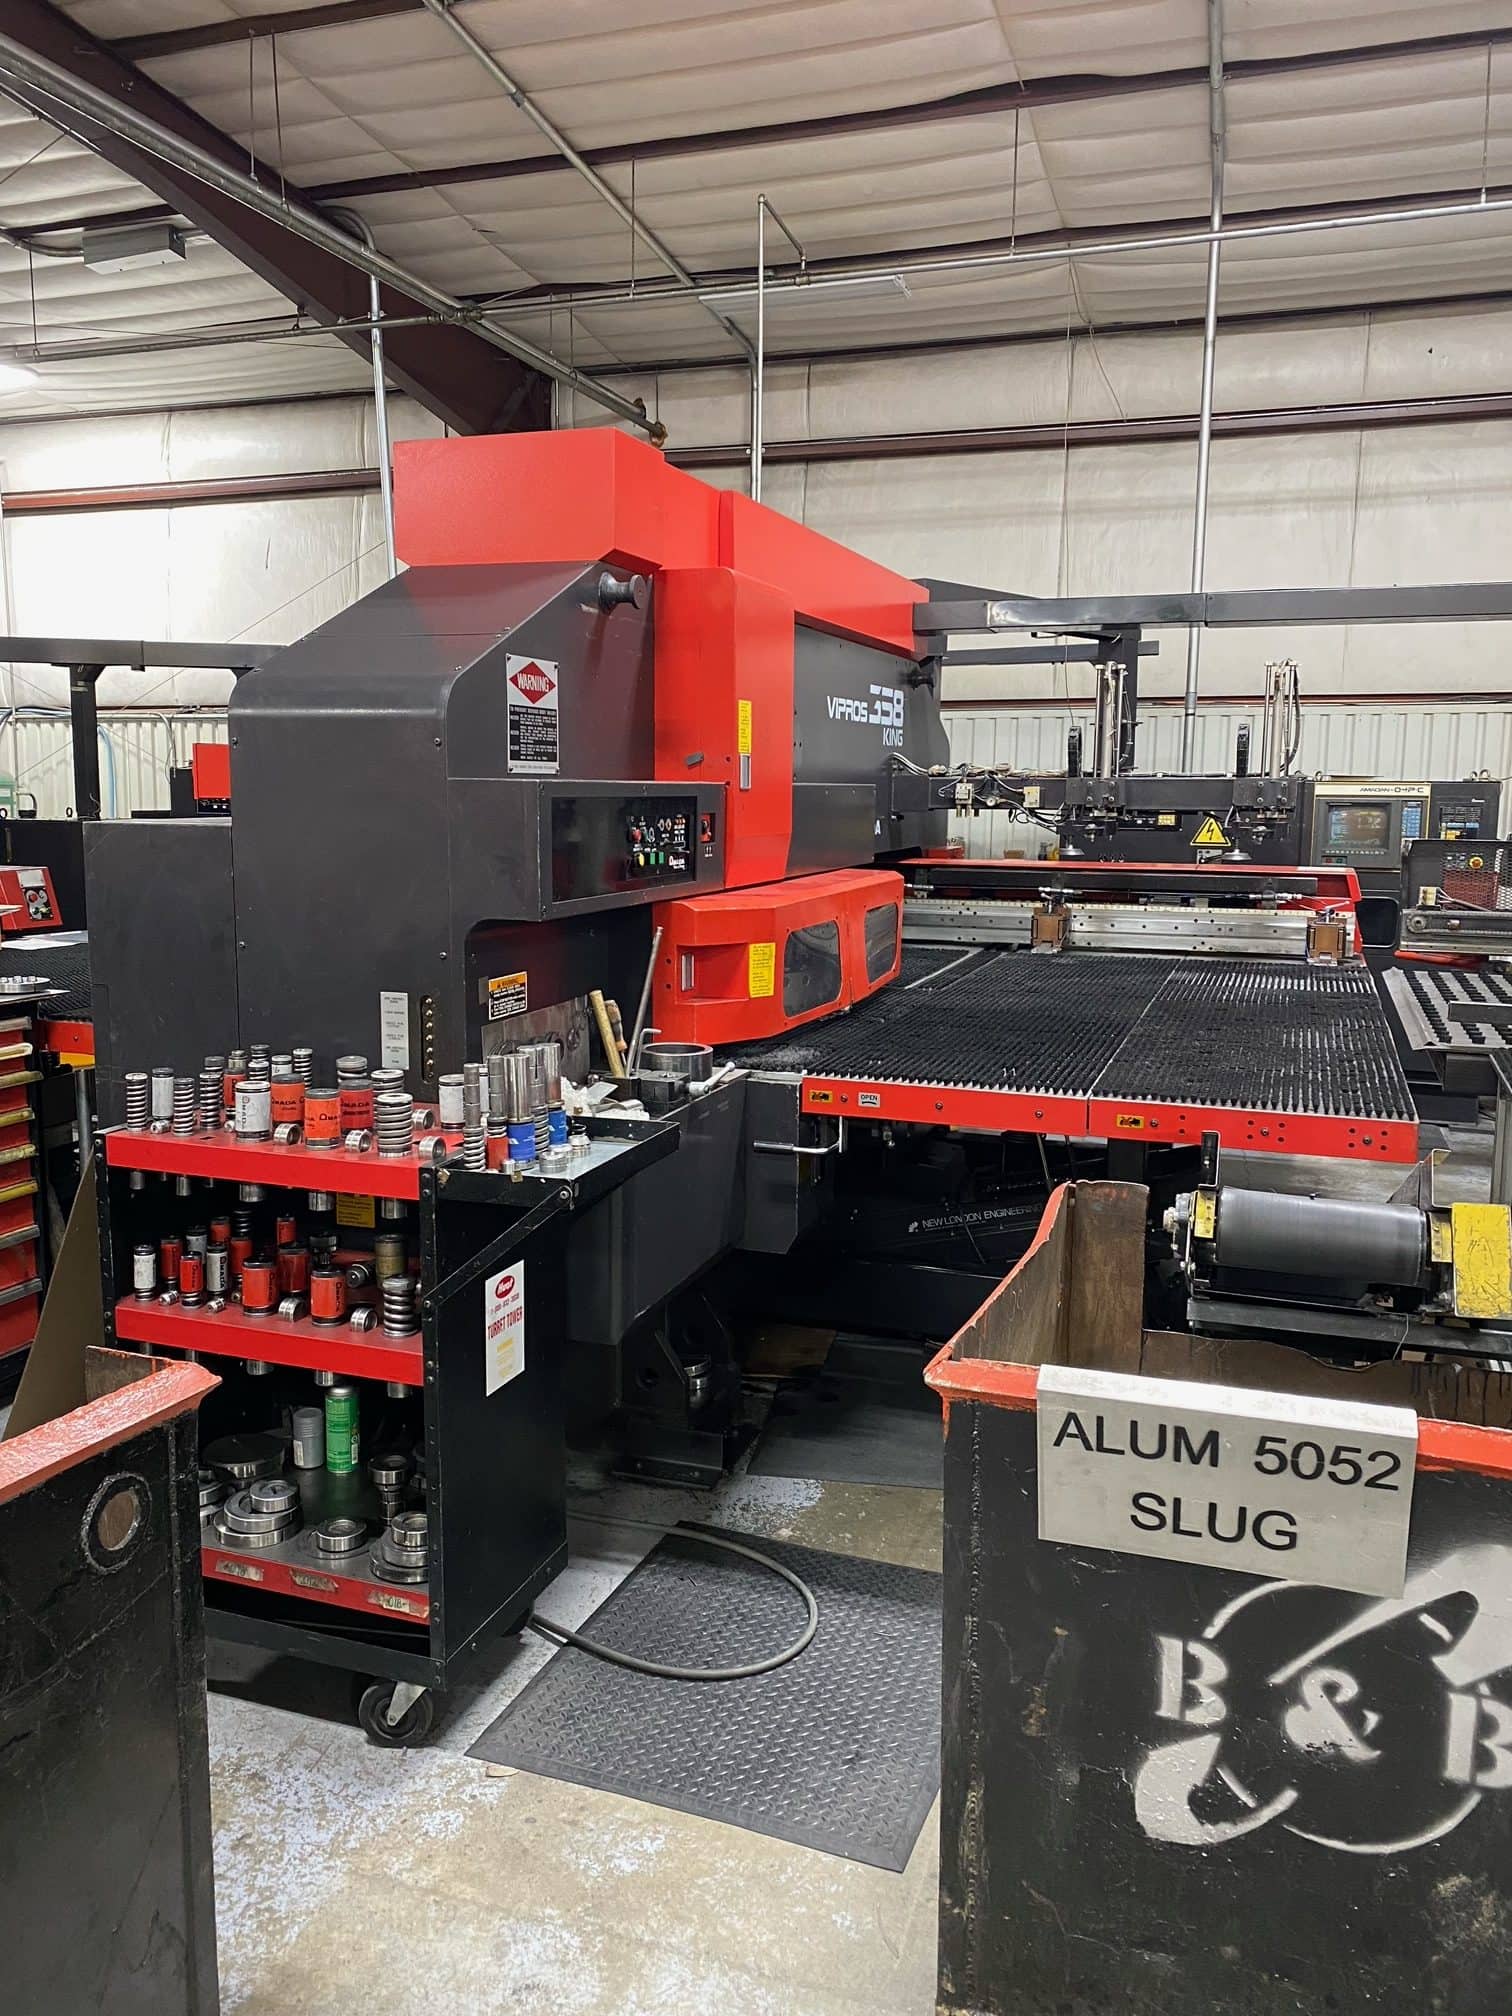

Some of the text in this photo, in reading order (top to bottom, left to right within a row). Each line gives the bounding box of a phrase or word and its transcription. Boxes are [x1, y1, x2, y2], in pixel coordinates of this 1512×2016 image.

[517, 672, 550, 693] WARNING
[827, 695, 868, 723] VIPROS
[883, 727, 904, 747] KING
[922, 1217, 944, 1229] NEW
[507, 1306, 523, 1329] TOWER
[1053, 1412, 1403, 1491] ALUM 5052
[1130, 1492, 1300, 1551] SLUG
[1153, 1632, 1512, 1789] B & B
